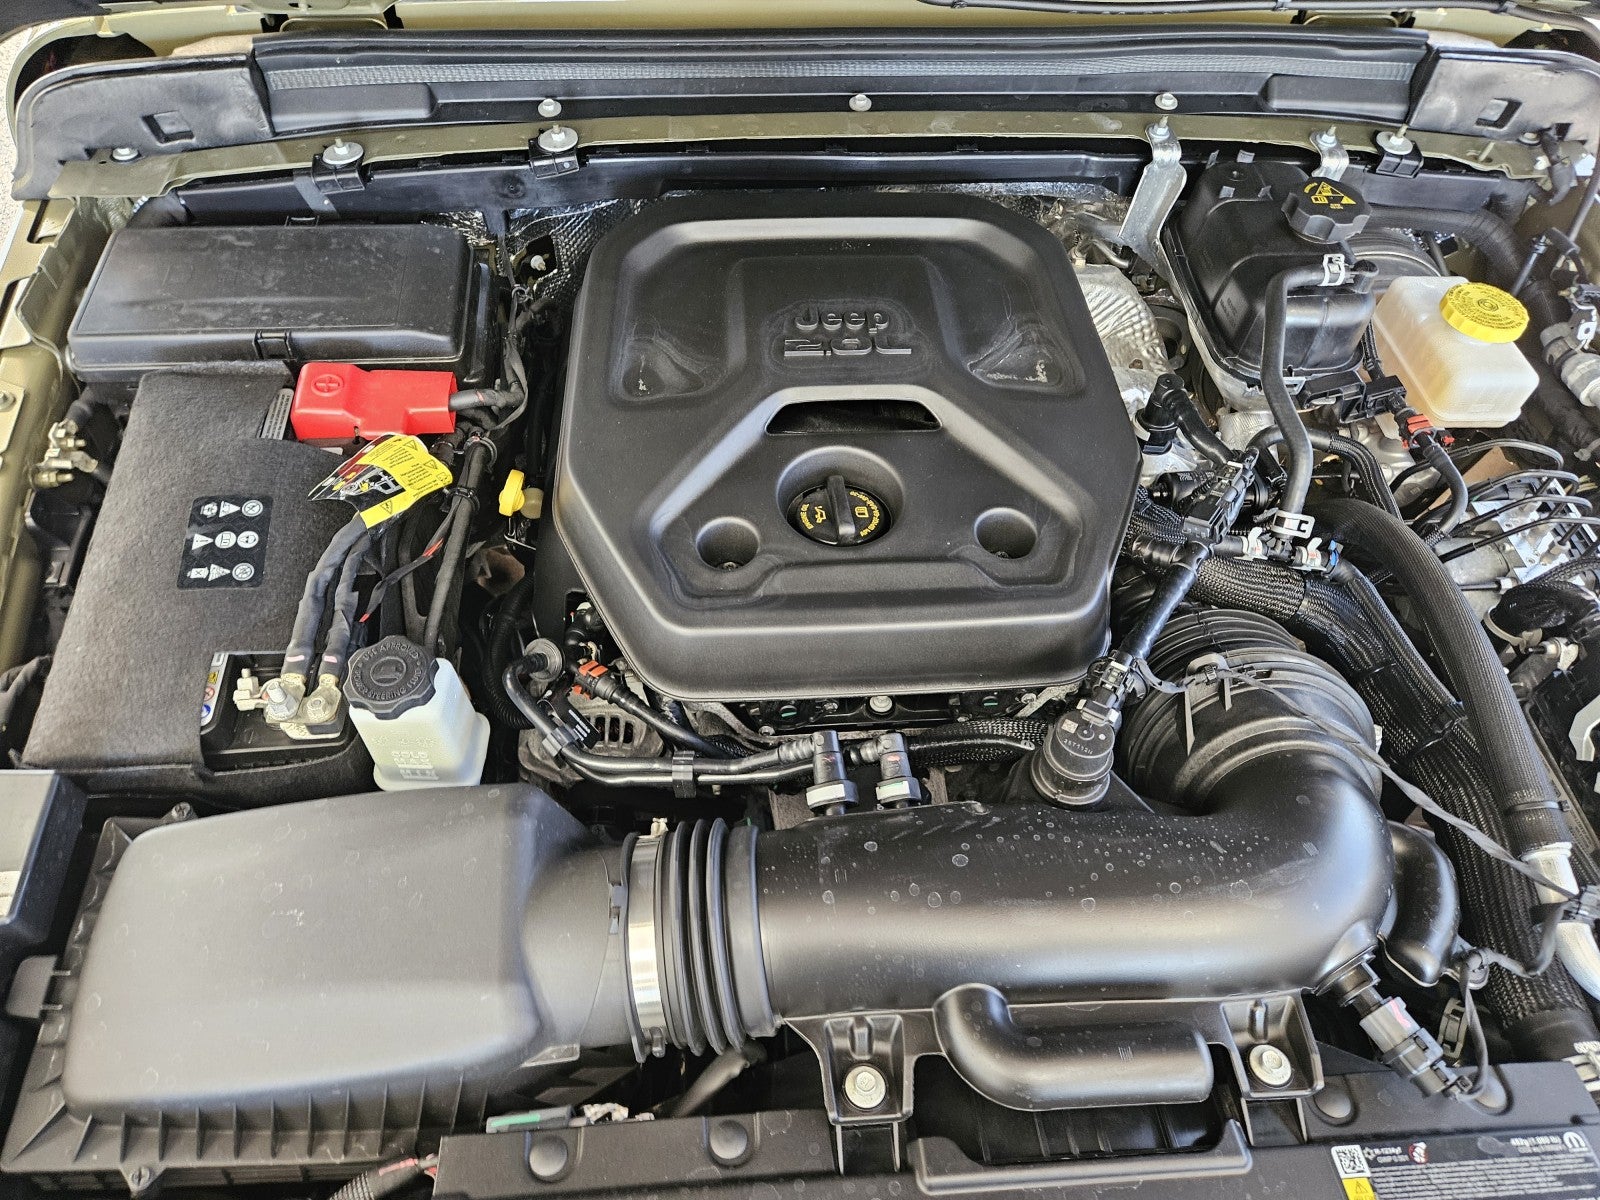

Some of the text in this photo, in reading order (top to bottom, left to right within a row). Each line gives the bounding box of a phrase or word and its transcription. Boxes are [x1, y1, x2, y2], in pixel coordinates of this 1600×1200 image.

[795, 305, 889, 334] Jeep
[783, 336, 912, 357] 2.0L
[363, 642, 421, 661] USE APPROVED
[354, 666, 423, 701] POWER STEERING FLUID
